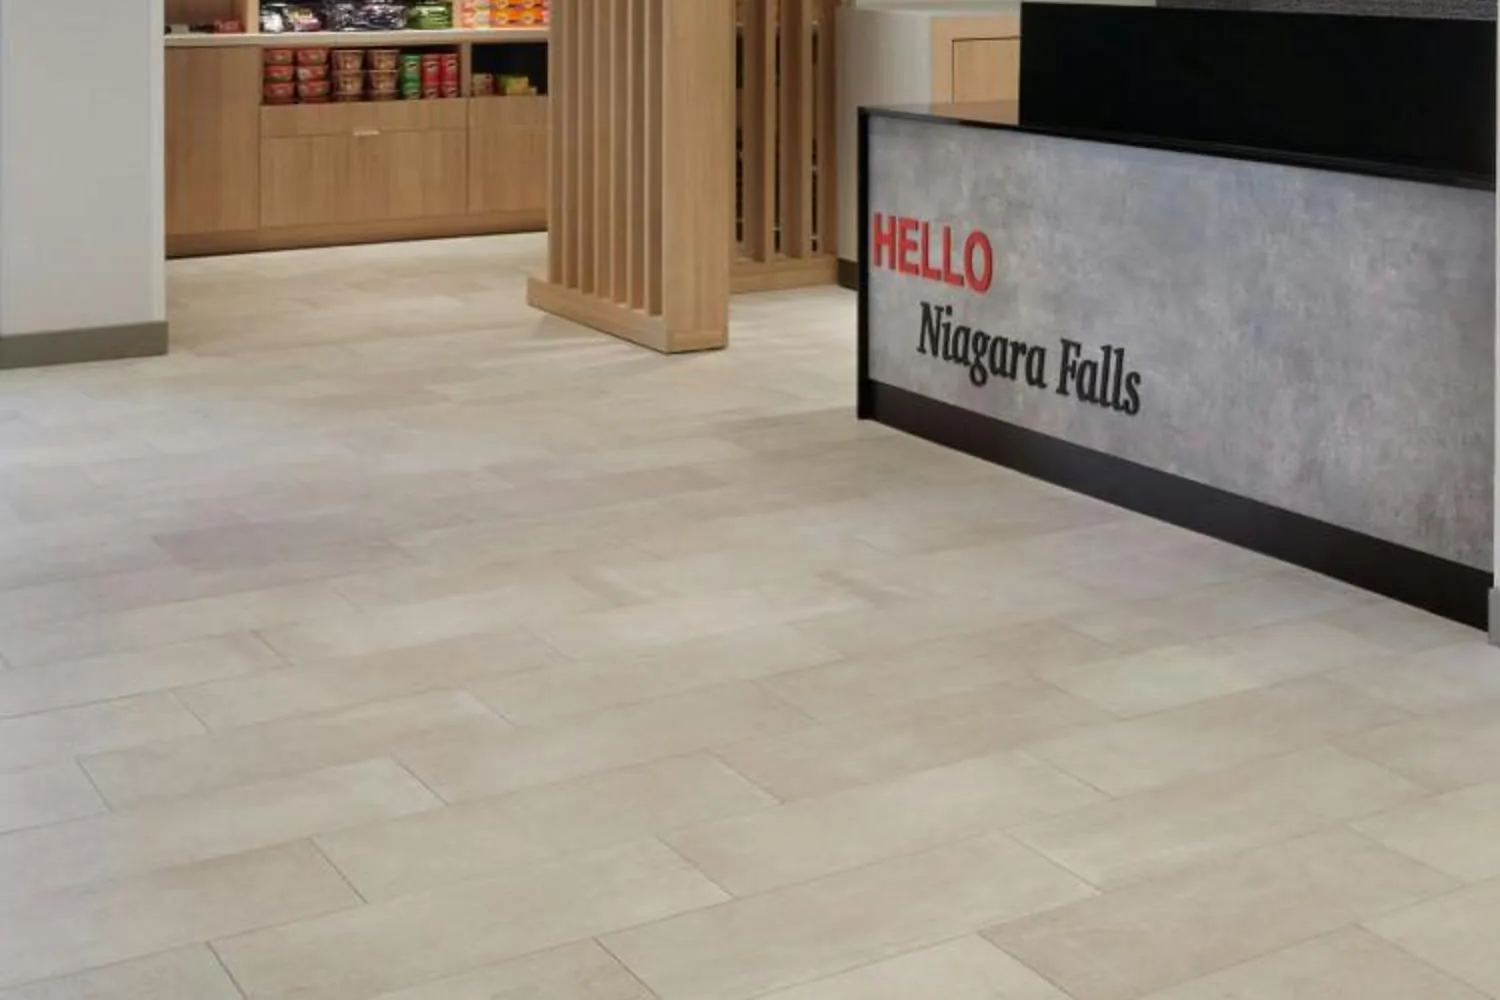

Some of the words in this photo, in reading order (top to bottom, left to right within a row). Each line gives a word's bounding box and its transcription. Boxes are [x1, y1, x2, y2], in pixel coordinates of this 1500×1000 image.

[873, 212, 993, 295] HELLO
[917, 302, 1047, 388] Niagara
[1056, 338, 1142, 416] Falls
